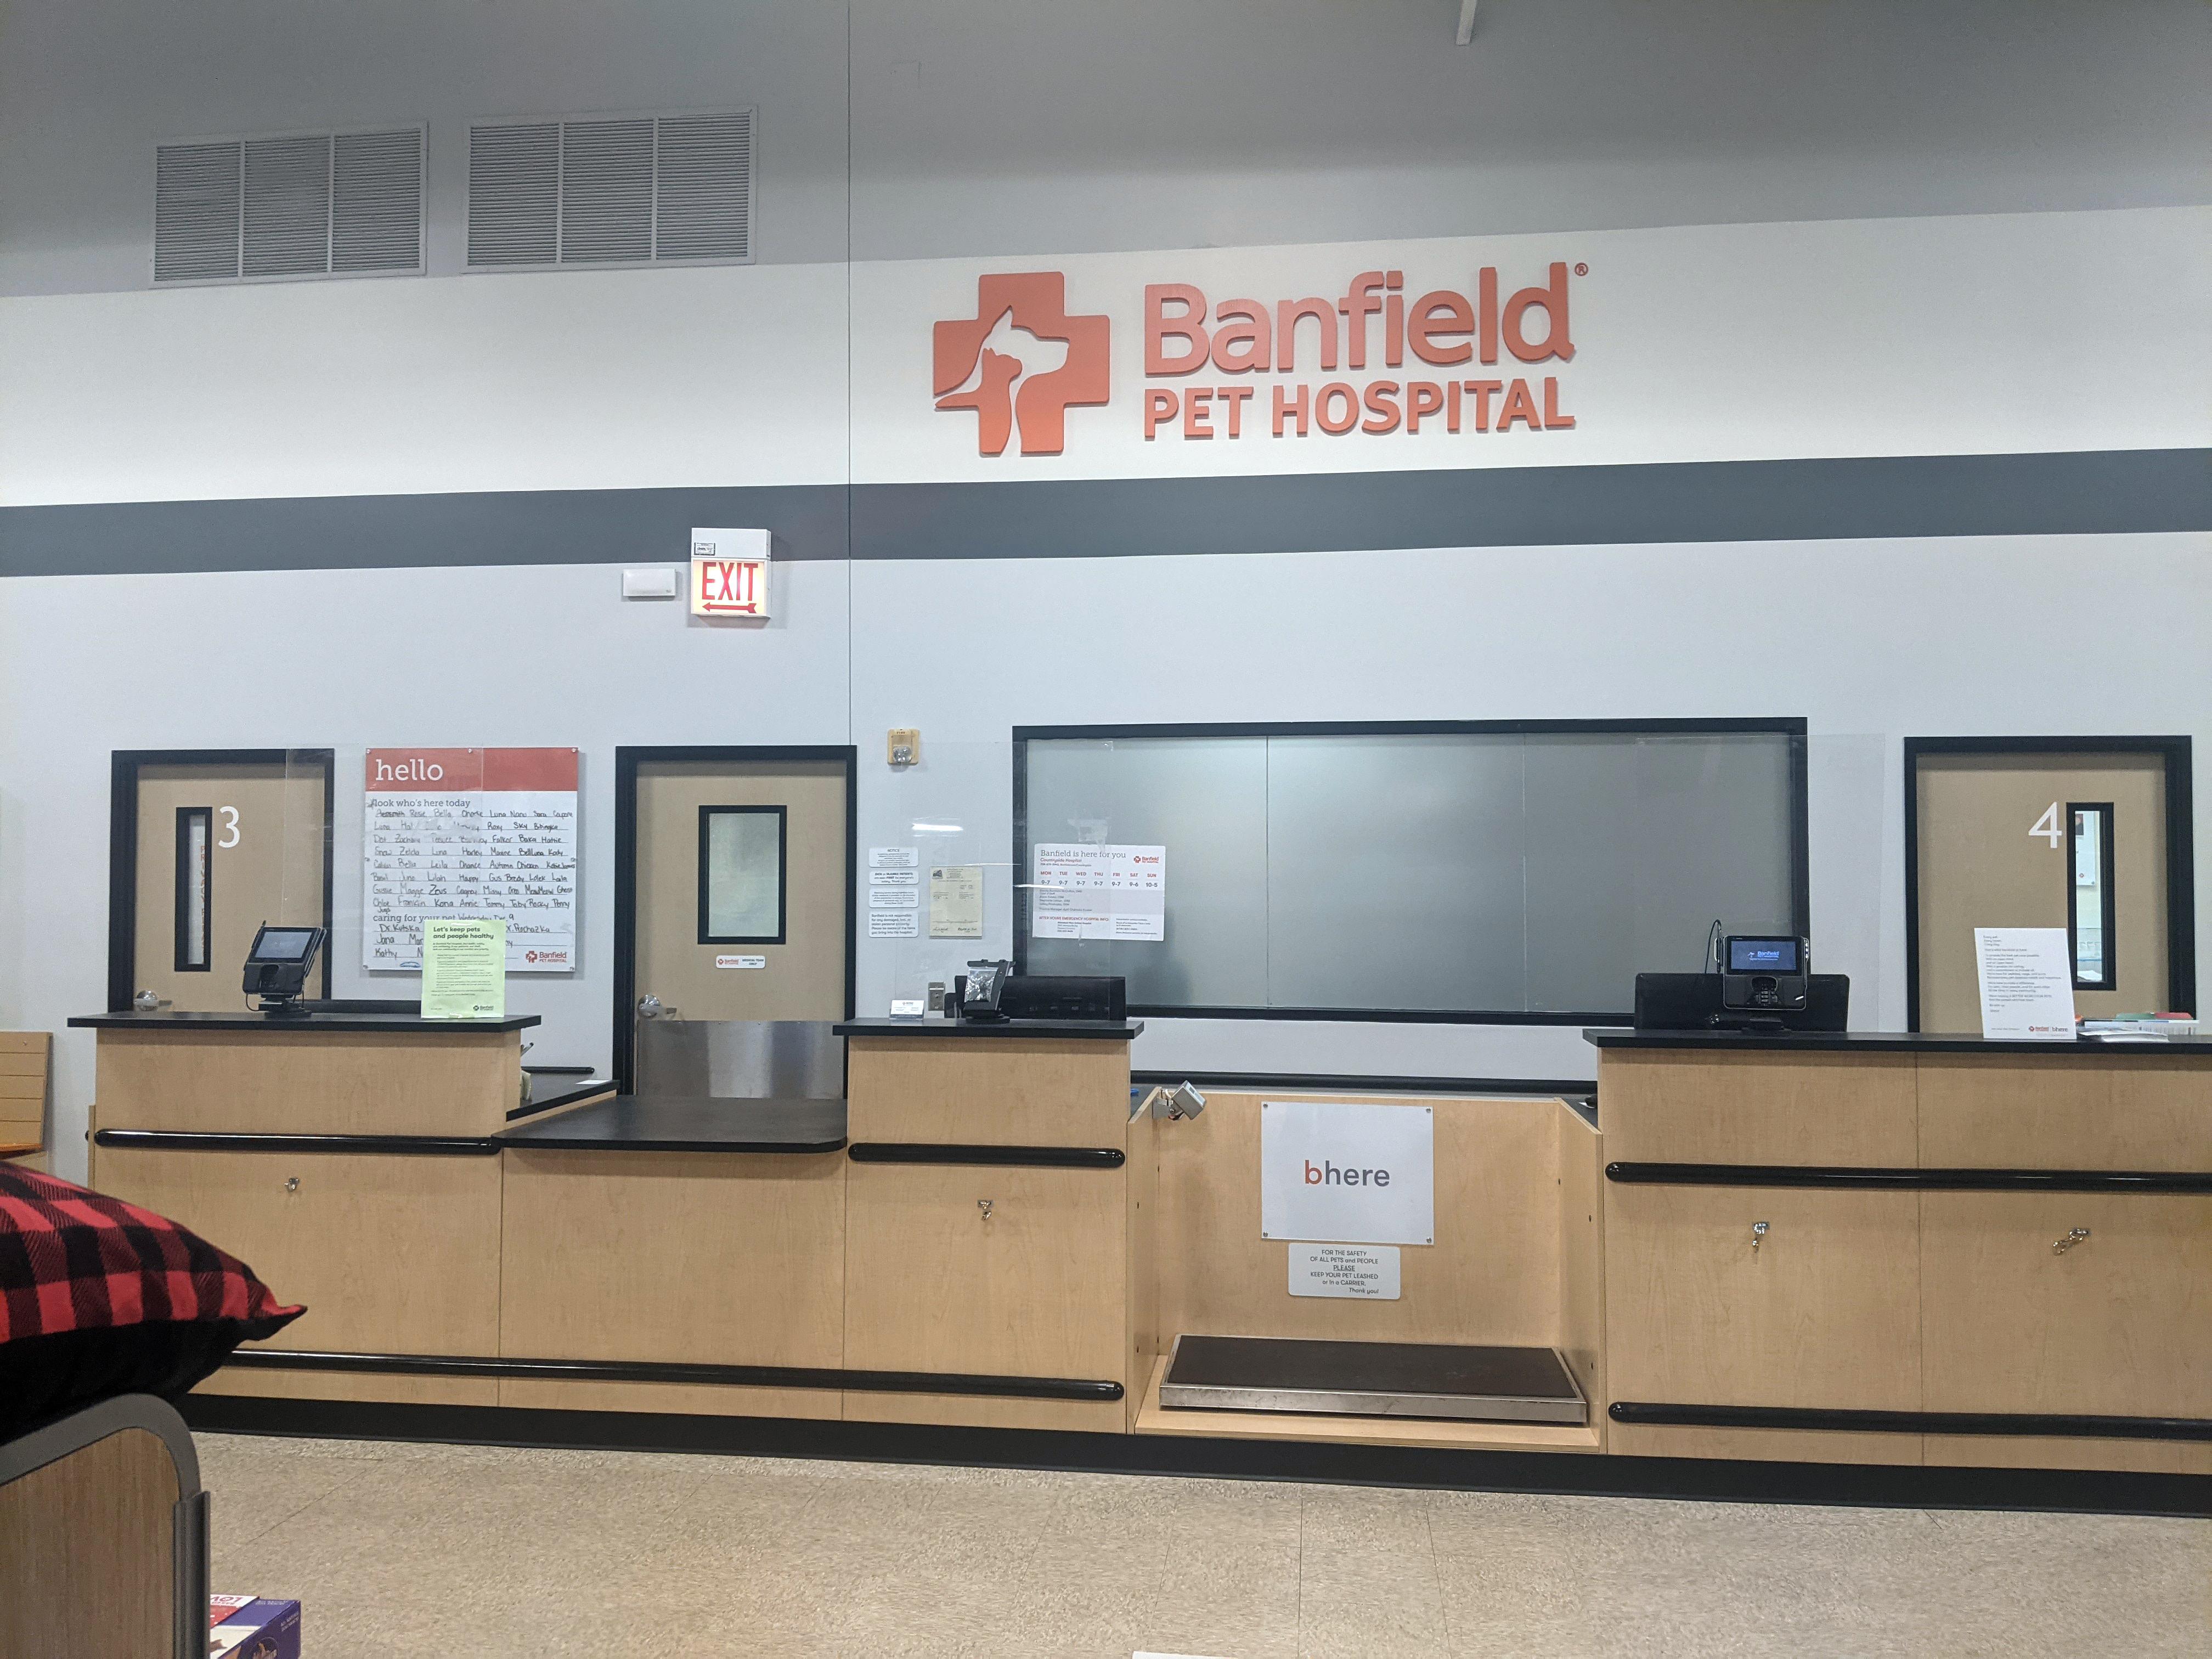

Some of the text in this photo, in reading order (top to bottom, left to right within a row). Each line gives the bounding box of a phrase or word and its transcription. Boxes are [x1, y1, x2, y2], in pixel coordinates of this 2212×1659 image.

[1144, 377, 1576, 441] PET HOSPITAL
[701, 562, 759, 602] EXIT
[375, 759, 443, 781] hello
[396, 799, 422, 807] who's
[446, 799, 470, 808] today
[218, 806, 240, 848] 3
[2028, 802, 2062, 849] 4
[428, 884, 447, 895] Zeus
[373, 915, 402, 923] caring
[404, 913, 417, 922] for
[1305, 1159, 1390, 1187] bhere
